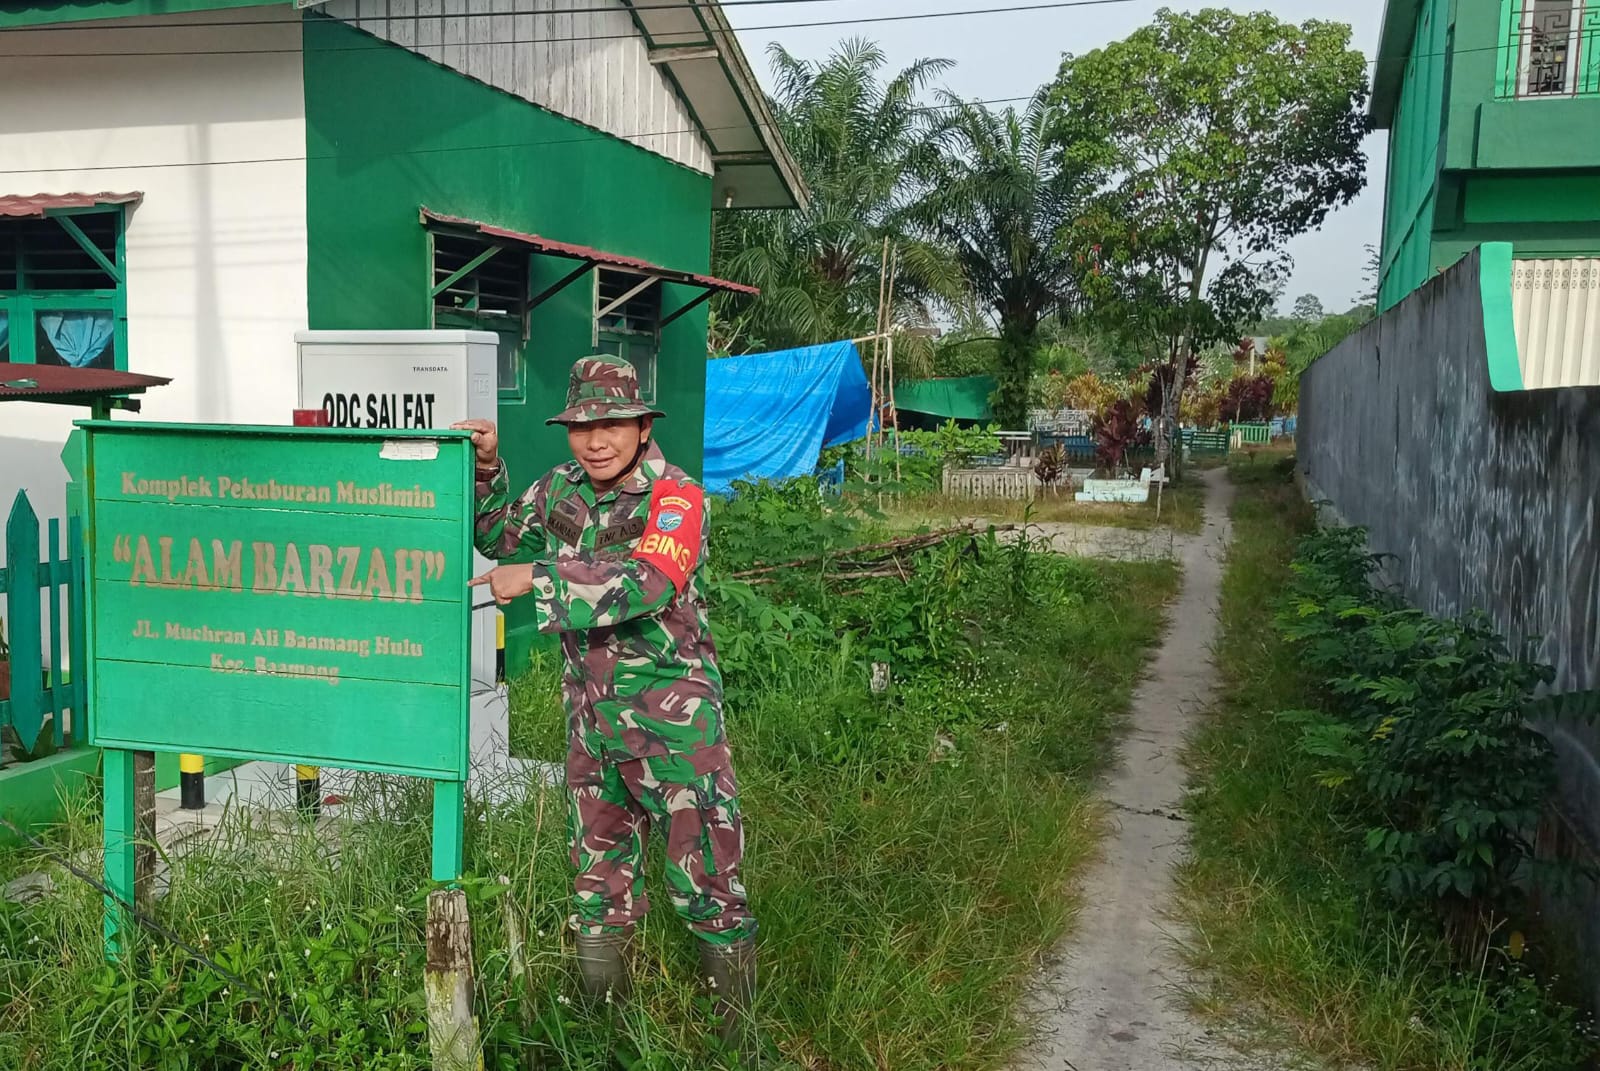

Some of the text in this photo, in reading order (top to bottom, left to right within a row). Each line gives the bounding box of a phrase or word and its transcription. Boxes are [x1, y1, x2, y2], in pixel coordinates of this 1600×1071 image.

[403, 393, 435, 429] FAT
[121, 471, 435, 509] Komplek Pekuburan Muslimin
[636, 533, 694, 578] BINS
[251, 628, 279, 647] Ali
[283, 630, 370, 657] Baamang
[375, 636, 424, 657] Hulu
[210, 653, 340, 685] Kec. Baamang
